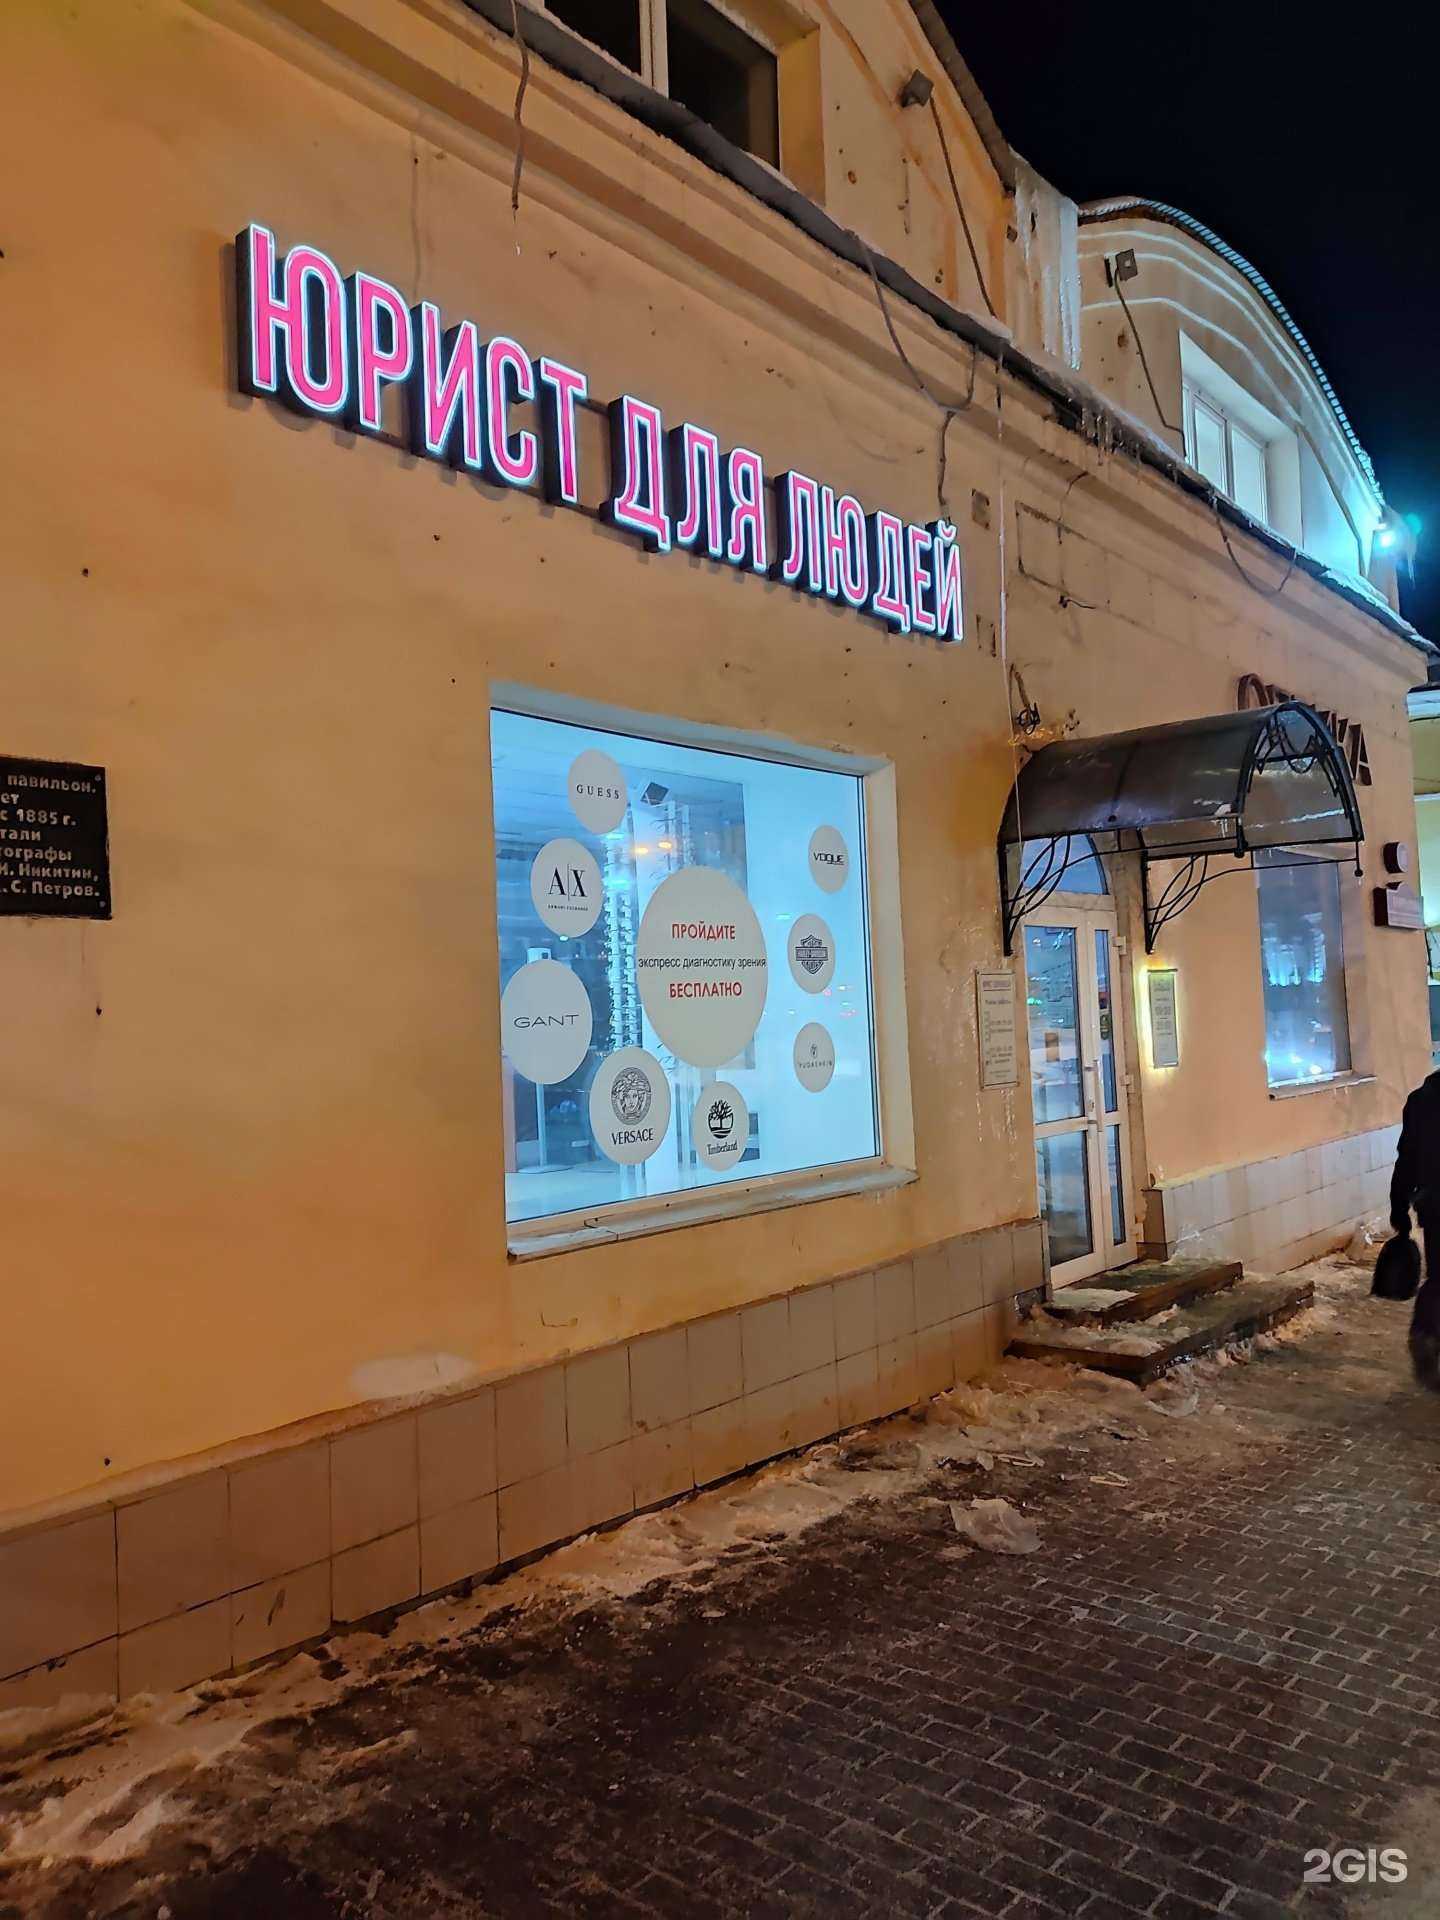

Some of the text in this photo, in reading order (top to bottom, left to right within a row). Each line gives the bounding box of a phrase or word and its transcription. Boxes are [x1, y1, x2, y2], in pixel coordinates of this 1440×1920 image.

[248, 223, 964, 642] ЮРИСТ ДЛЯ ЛЮДЕЙ
[7, 774, 97, 794] павильон.
[576, 784, 621, 800] GUESS
[16, 808, 58, 826] 1885
[62, 814, 77, 826] г.
[0, 846, 72, 863] ографы
[18, 863, 98, 882] Никитин,
[32, 880, 100, 899] Петров.
[671, 920, 736, 941] ПРОЙДИТЕ
[638, 957, 767, 970] экспресс диагностику зрения
[669, 982, 743, 998] БЕСПЛАТНО
[513, 1014, 579, 1029] GANT
[611, 1127, 654, 1146] VERSACE
[707, 1141, 738, 1155] Timberland
